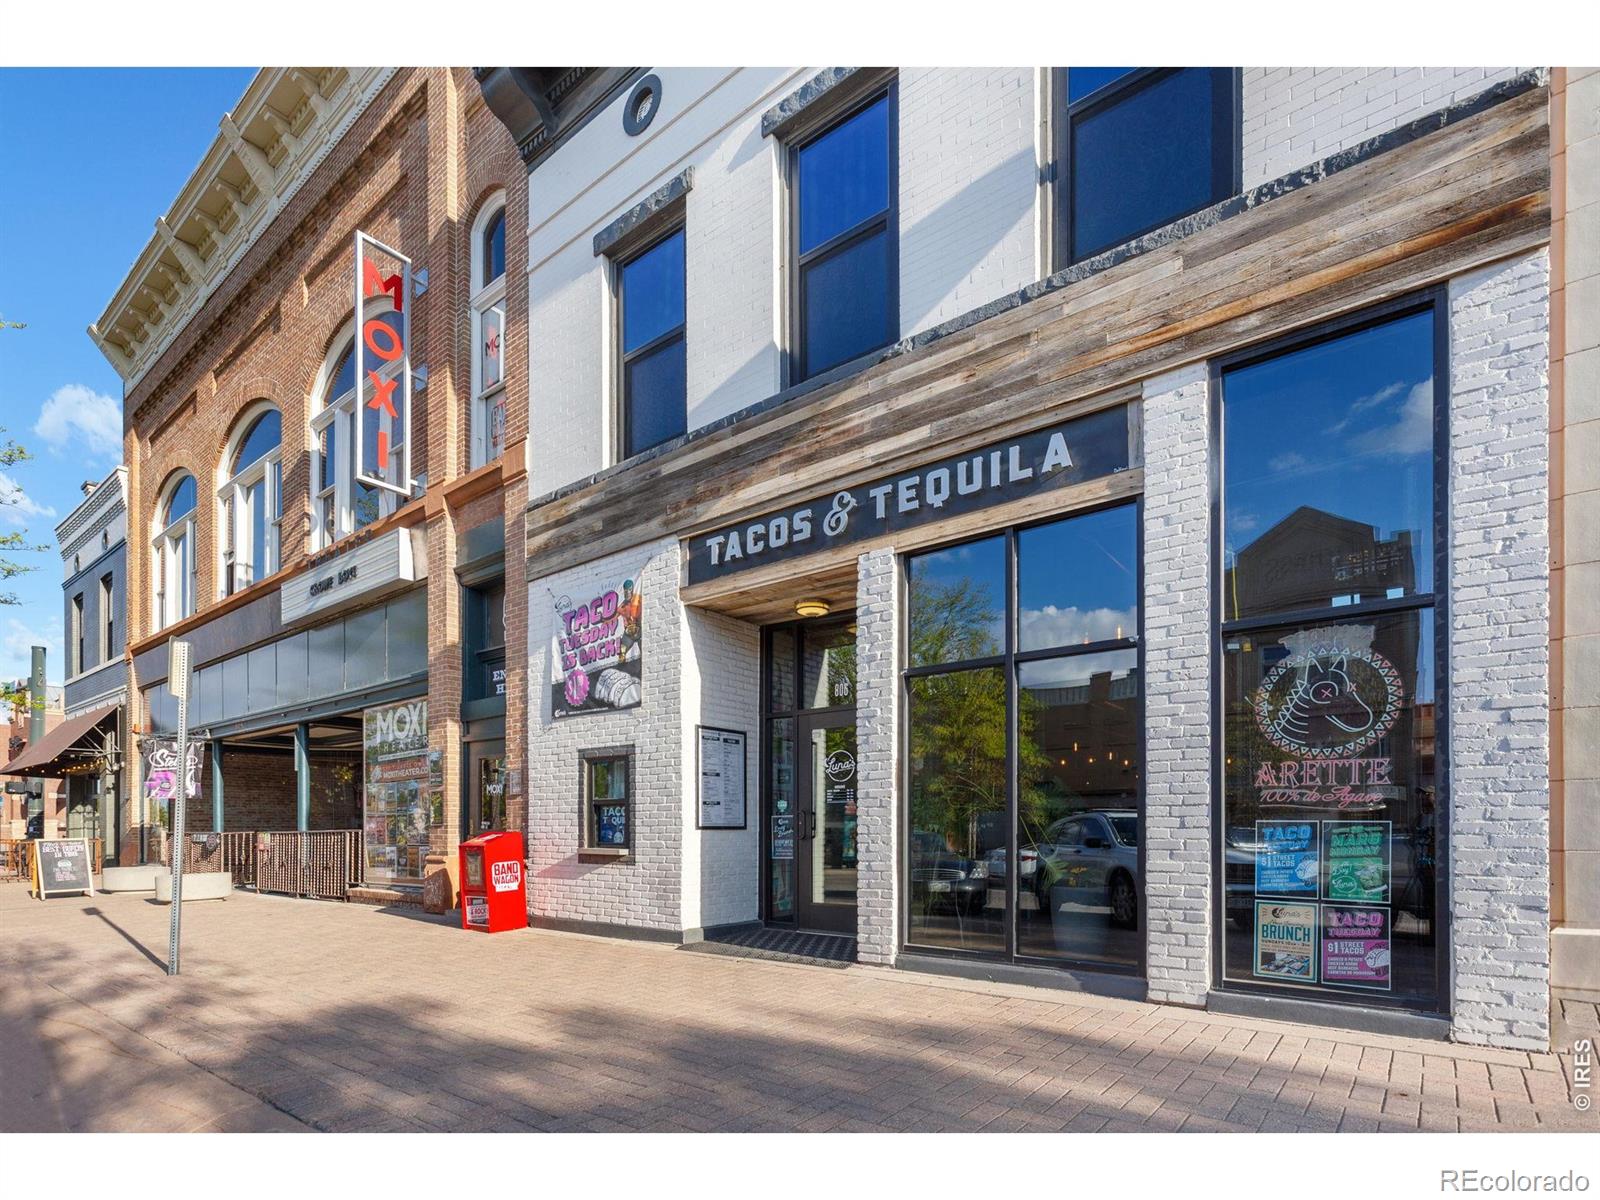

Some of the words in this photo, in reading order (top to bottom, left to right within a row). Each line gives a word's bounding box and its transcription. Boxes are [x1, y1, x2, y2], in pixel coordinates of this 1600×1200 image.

[363, 256, 404, 469] MOXI
[706, 509, 812, 566] TACOS
[823, 490, 857, 537] &
[869, 432, 1073, 519] TEQUILA
[563, 590, 619, 636] TACO
[560, 618, 618, 655] TUESDAY
[561, 653, 577, 672] IS
[579, 636, 622, 667] BACK!
[834, 682, 849, 697] 806
[376, 701, 428, 745] MOXI
[377, 736, 428, 752] THEATER
[825, 757, 856, 774] Luna's
[1254, 758, 1392, 788] ARETTE
[1260, 788, 1300, 802] 100%
[1322, 786, 1383, 808] Agave
[1263, 825, 1312, 841] TACO
[494, 862, 519, 876] BAND
[494, 874, 519, 885] WAGON
[1327, 911, 1384, 928] TACO
[1262, 924, 1310, 942] BRUNCH
